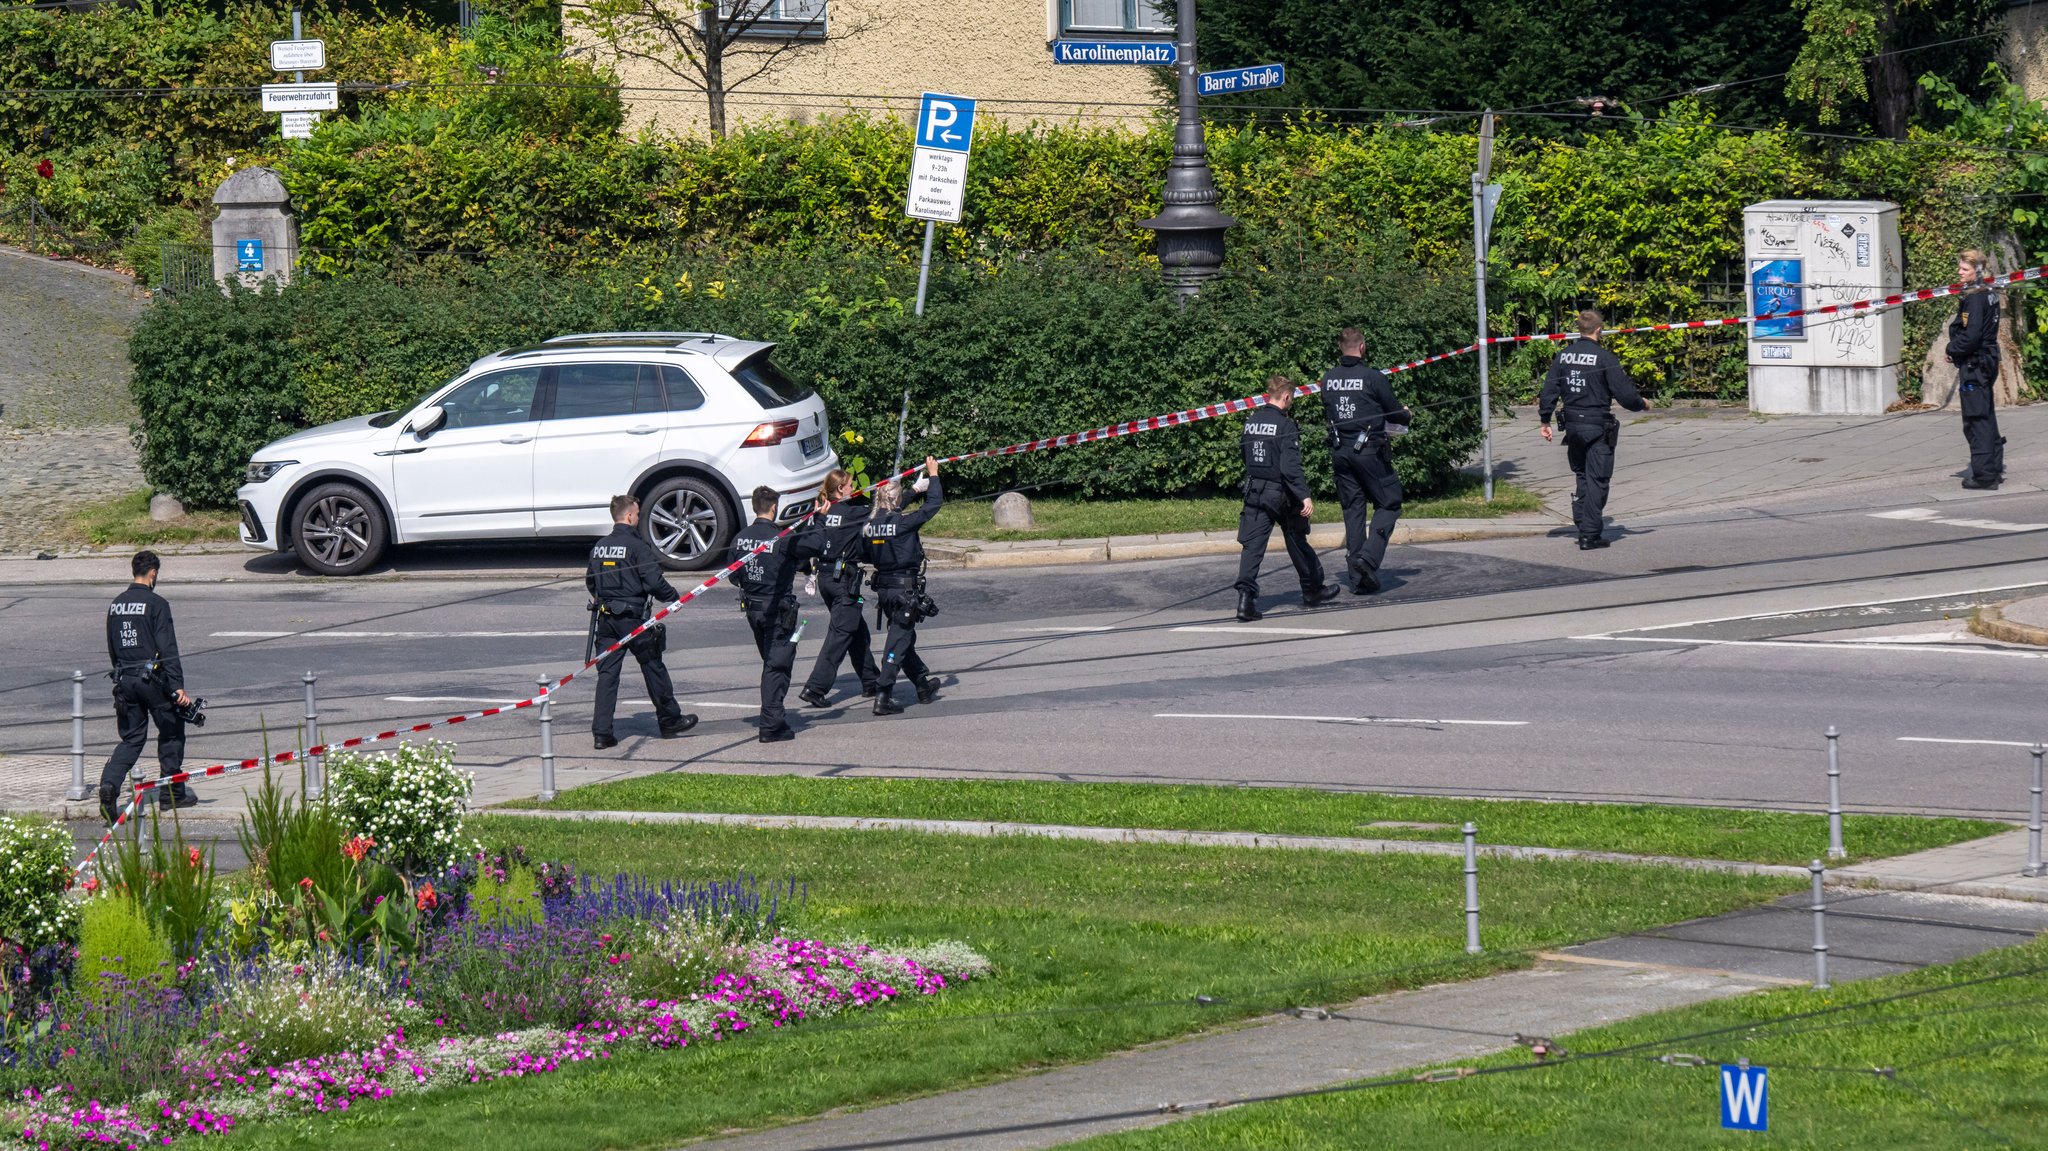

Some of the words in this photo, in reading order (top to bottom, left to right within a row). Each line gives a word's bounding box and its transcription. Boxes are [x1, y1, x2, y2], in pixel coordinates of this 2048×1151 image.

[1061, 44, 1170, 64] Karolinenplatz
[1204, 75, 1237, 92] Barer
[1242, 68, 1279, 87] Straße
[269, 92, 331, 101] Feuerwehrzufahrt
[926, 100, 958, 141] P
[929, 154, 953, 163] werktags
[931, 164, 948, 172] 9-23h
[929, 175, 958, 184] Parkschein
[918, 195, 951, 205] Parkausweis
[244, 242, 255, 257] 4
[1757, 286, 1796, 297] CIRQUE
[1559, 352, 1598, 366] POLIZEI
[1571, 370, 1581, 378] BY
[1326, 379, 1363, 391] POLIZEI
[1566, 377, 1586, 386] 1421
[1340, 396, 1350, 404] BY
[1244, 423, 1277, 436] POLIZEI
[1253, 441, 1264, 449] BY
[1252, 449, 1266, 457] 1421
[593, 546, 627, 559] POLIZEI
[744, 565, 764, 574] 1426
[110, 603, 146, 615] POLIZEI
[122, 621, 132, 629] BY
[120, 630, 137, 638] 1426
[122, 638, 138, 647] BeSi
[1722, 1070, 1766, 1125] W
